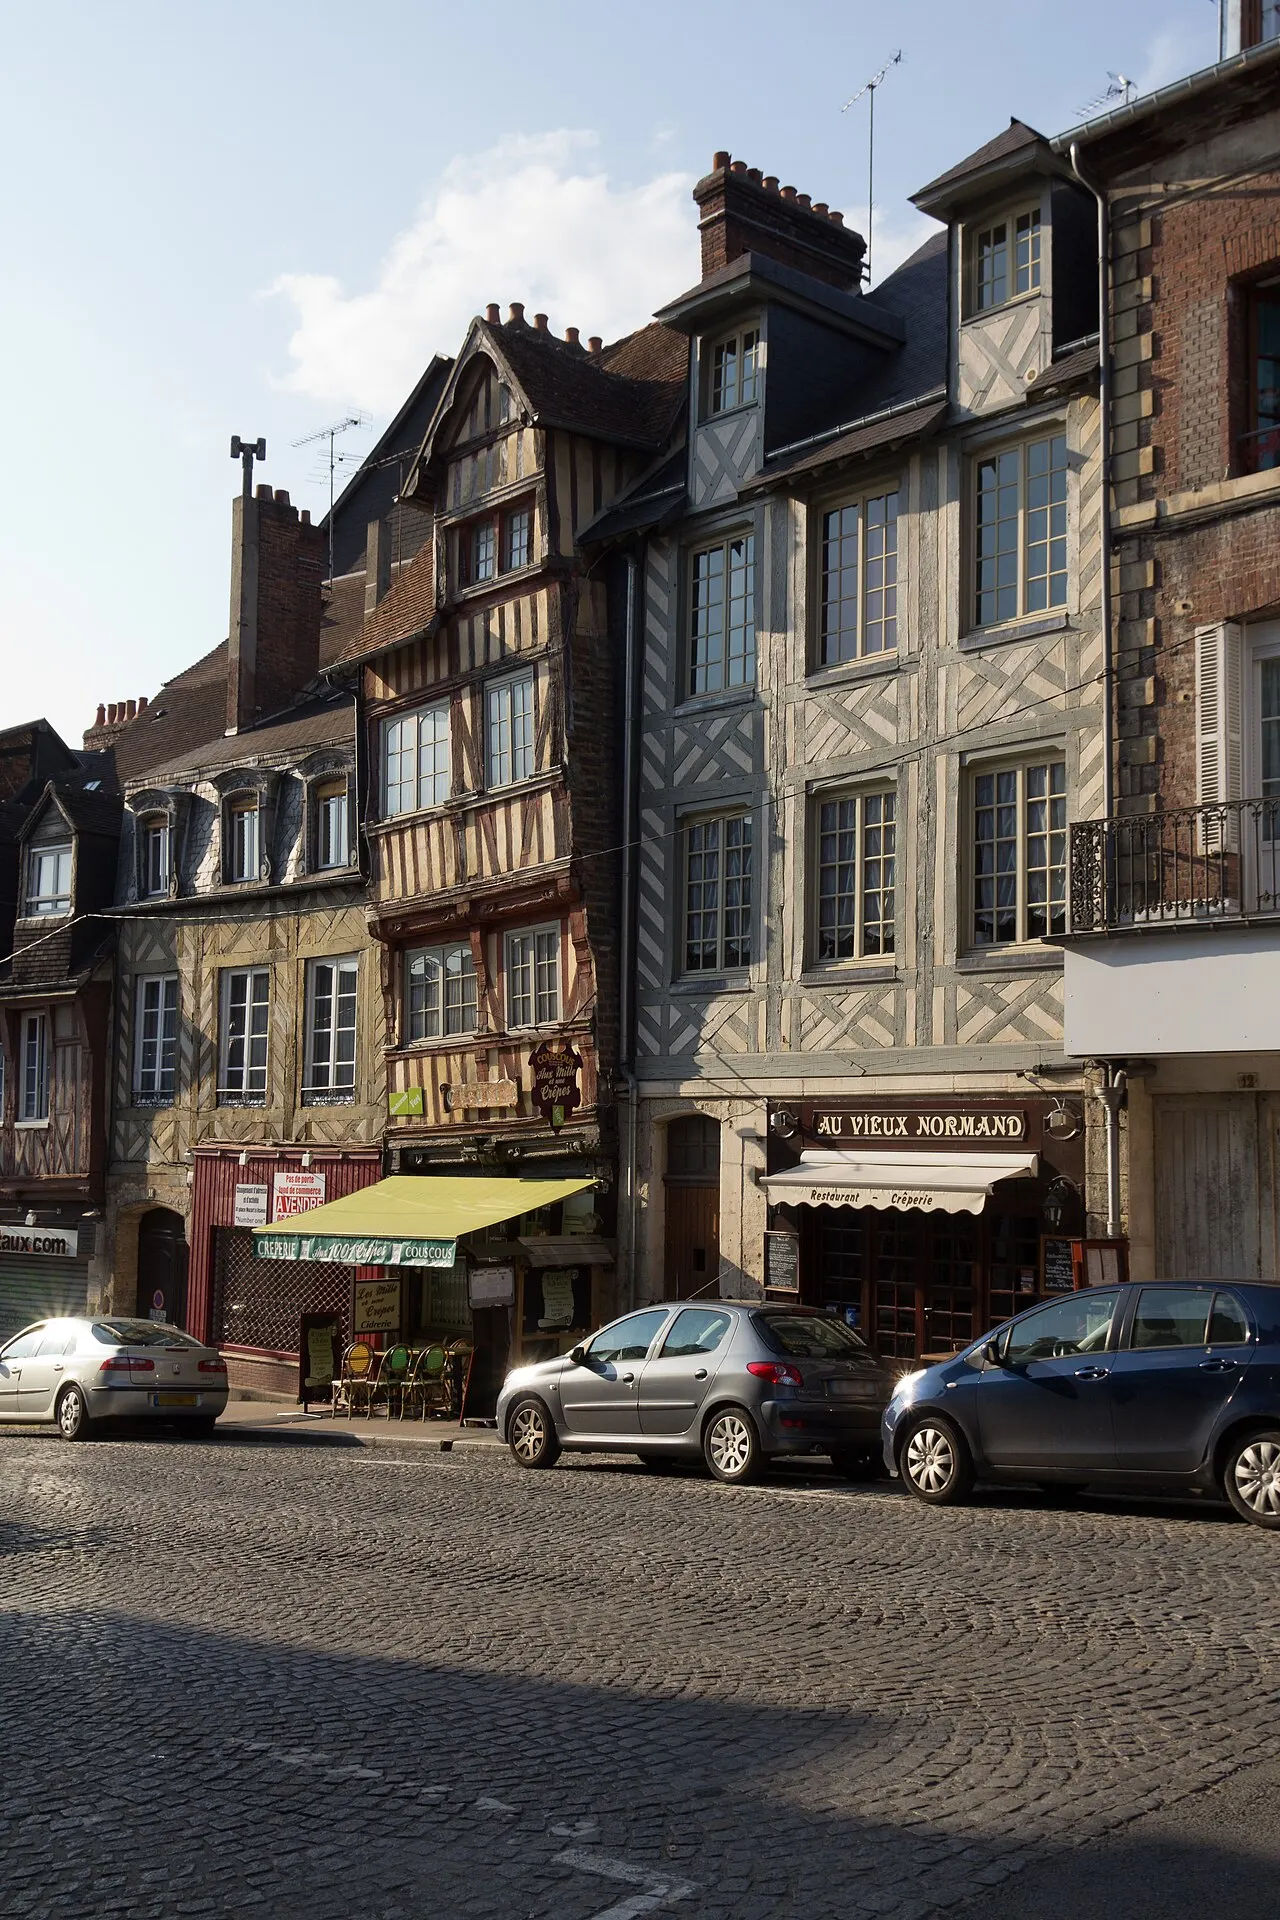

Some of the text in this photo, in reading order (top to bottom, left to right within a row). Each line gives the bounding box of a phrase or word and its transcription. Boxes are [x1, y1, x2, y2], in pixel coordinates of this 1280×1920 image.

[537, 1053, 575, 1066] COUSCOUS
[537, 1065, 576, 1080] Aux Mille
[541, 1085, 571, 1103] Crêpes
[817, 1114, 1023, 1136] AU VIEUX NORMAND
[286, 1175, 314, 1184] Pas de porte
[290, 1186, 295, 1194] de
[296, 1187, 321, 1195] commerce
[810, 1190, 860, 1204] Restaurant
[891, 1192, 933, 1206] Crêperie
[277, 1197, 323, 1213] A VENDRE
[328, 1242, 355, 1259] 1001
[405, 1246, 452, 1259] COUSCOUS
[357, 1284, 398, 1299] Les Mille
[361, 1320, 392, 1329] Cidrerie
